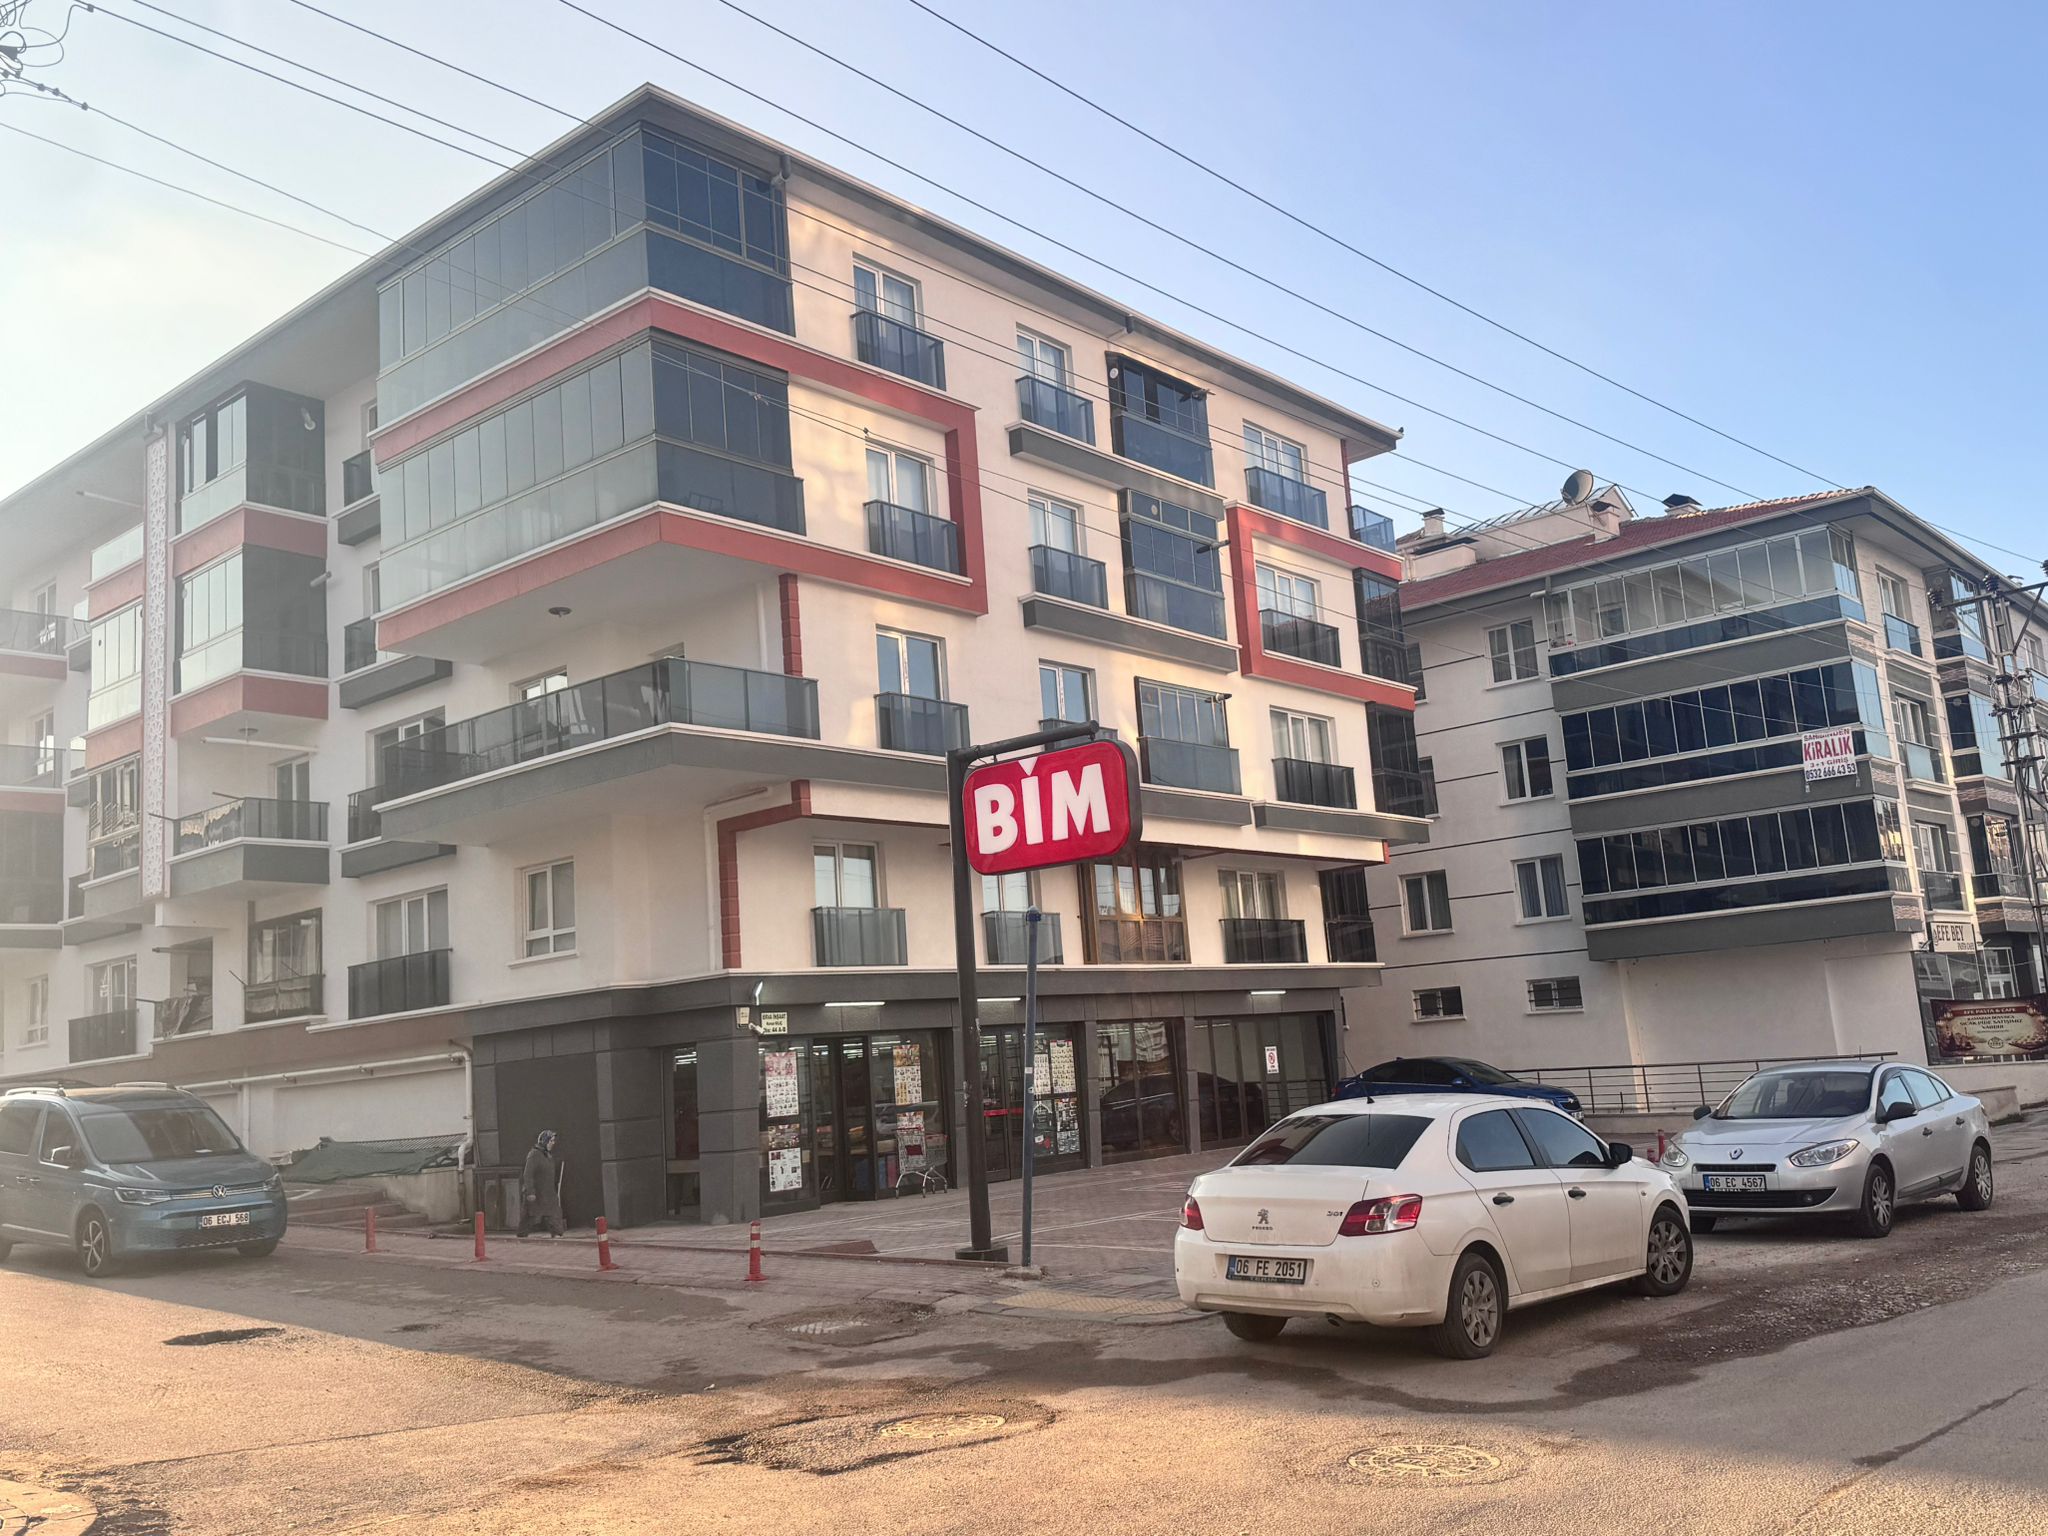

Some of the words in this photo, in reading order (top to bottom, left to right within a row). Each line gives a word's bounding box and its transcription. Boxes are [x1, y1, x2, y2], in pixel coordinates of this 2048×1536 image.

[1805, 768, 1822, 780] 0532
[1823, 766, 1836, 777] 666
[1837, 764, 1847, 775] 43
[1847, 762, 1856, 773] 53
[974, 757, 1111, 855] BİM
[1936, 925, 1951, 941] EFE
[1950, 925, 1964, 941] BEY
[1710, 1177, 1721, 1187] 06
[1725, 1177, 1737, 1187] EC
[1742, 1177, 1763, 1188] 4567
[203, 1217, 213, 1226] 06
[217, 1214, 231, 1225] ECJ
[1235, 1259, 1249, 1274] 06
[1256, 1260, 1270, 1276] FE
[1275, 1261, 1302, 1277] 2051
